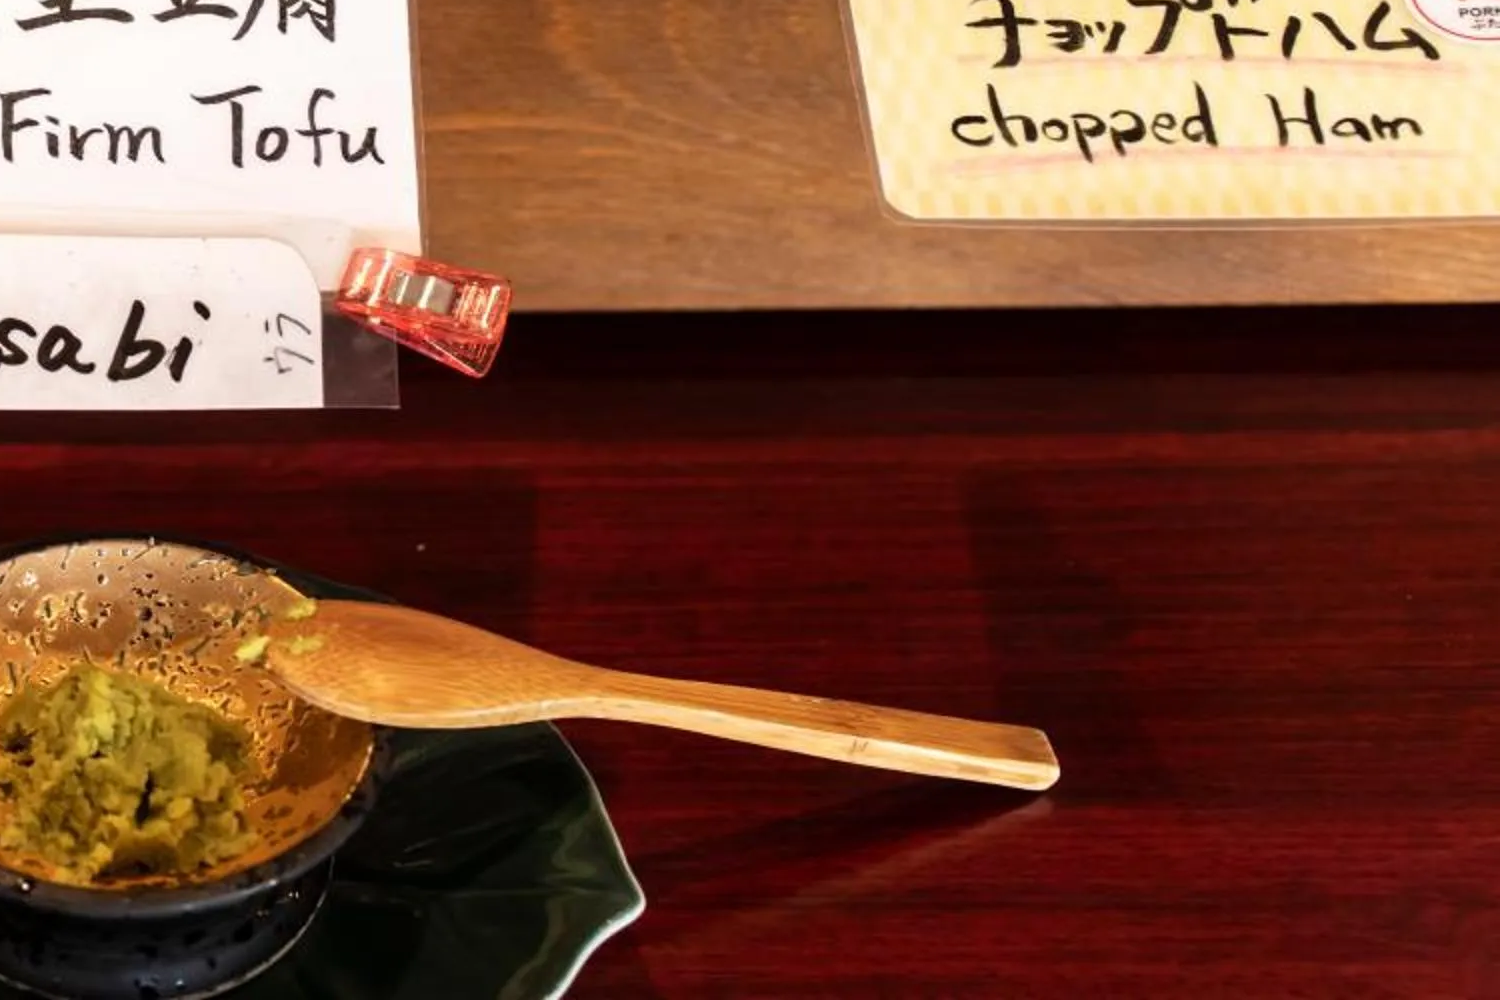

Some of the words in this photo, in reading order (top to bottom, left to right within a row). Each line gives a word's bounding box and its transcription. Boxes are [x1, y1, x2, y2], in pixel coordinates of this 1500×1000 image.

[190, 85, 386, 167] Tofu
[950, 82, 1218, 163] chopped
[1265, 87, 1423, 147] Ham
